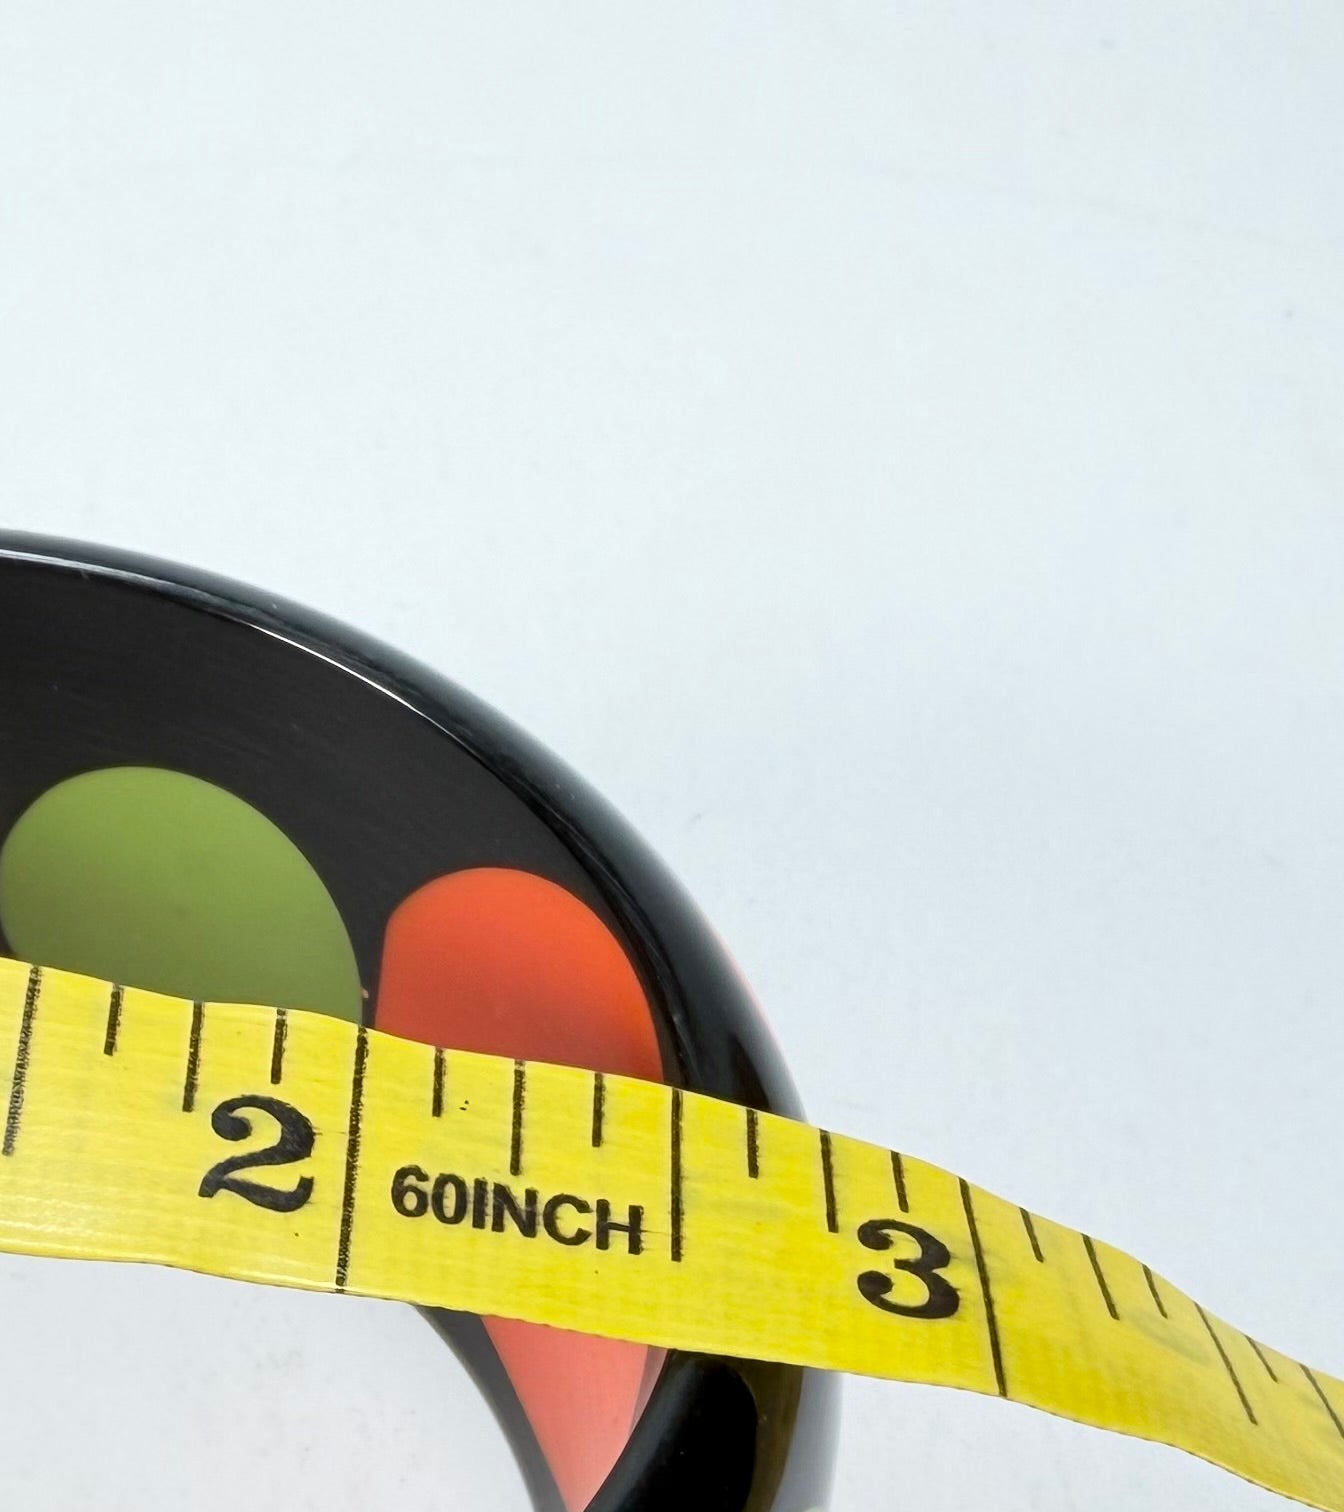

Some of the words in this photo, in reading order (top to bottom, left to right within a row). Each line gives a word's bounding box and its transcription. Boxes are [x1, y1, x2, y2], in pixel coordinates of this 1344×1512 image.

[198, 1094, 316, 1212] 2
[389, 1164, 644, 1256] 60INCH
[856, 1218, 960, 1320] 3
